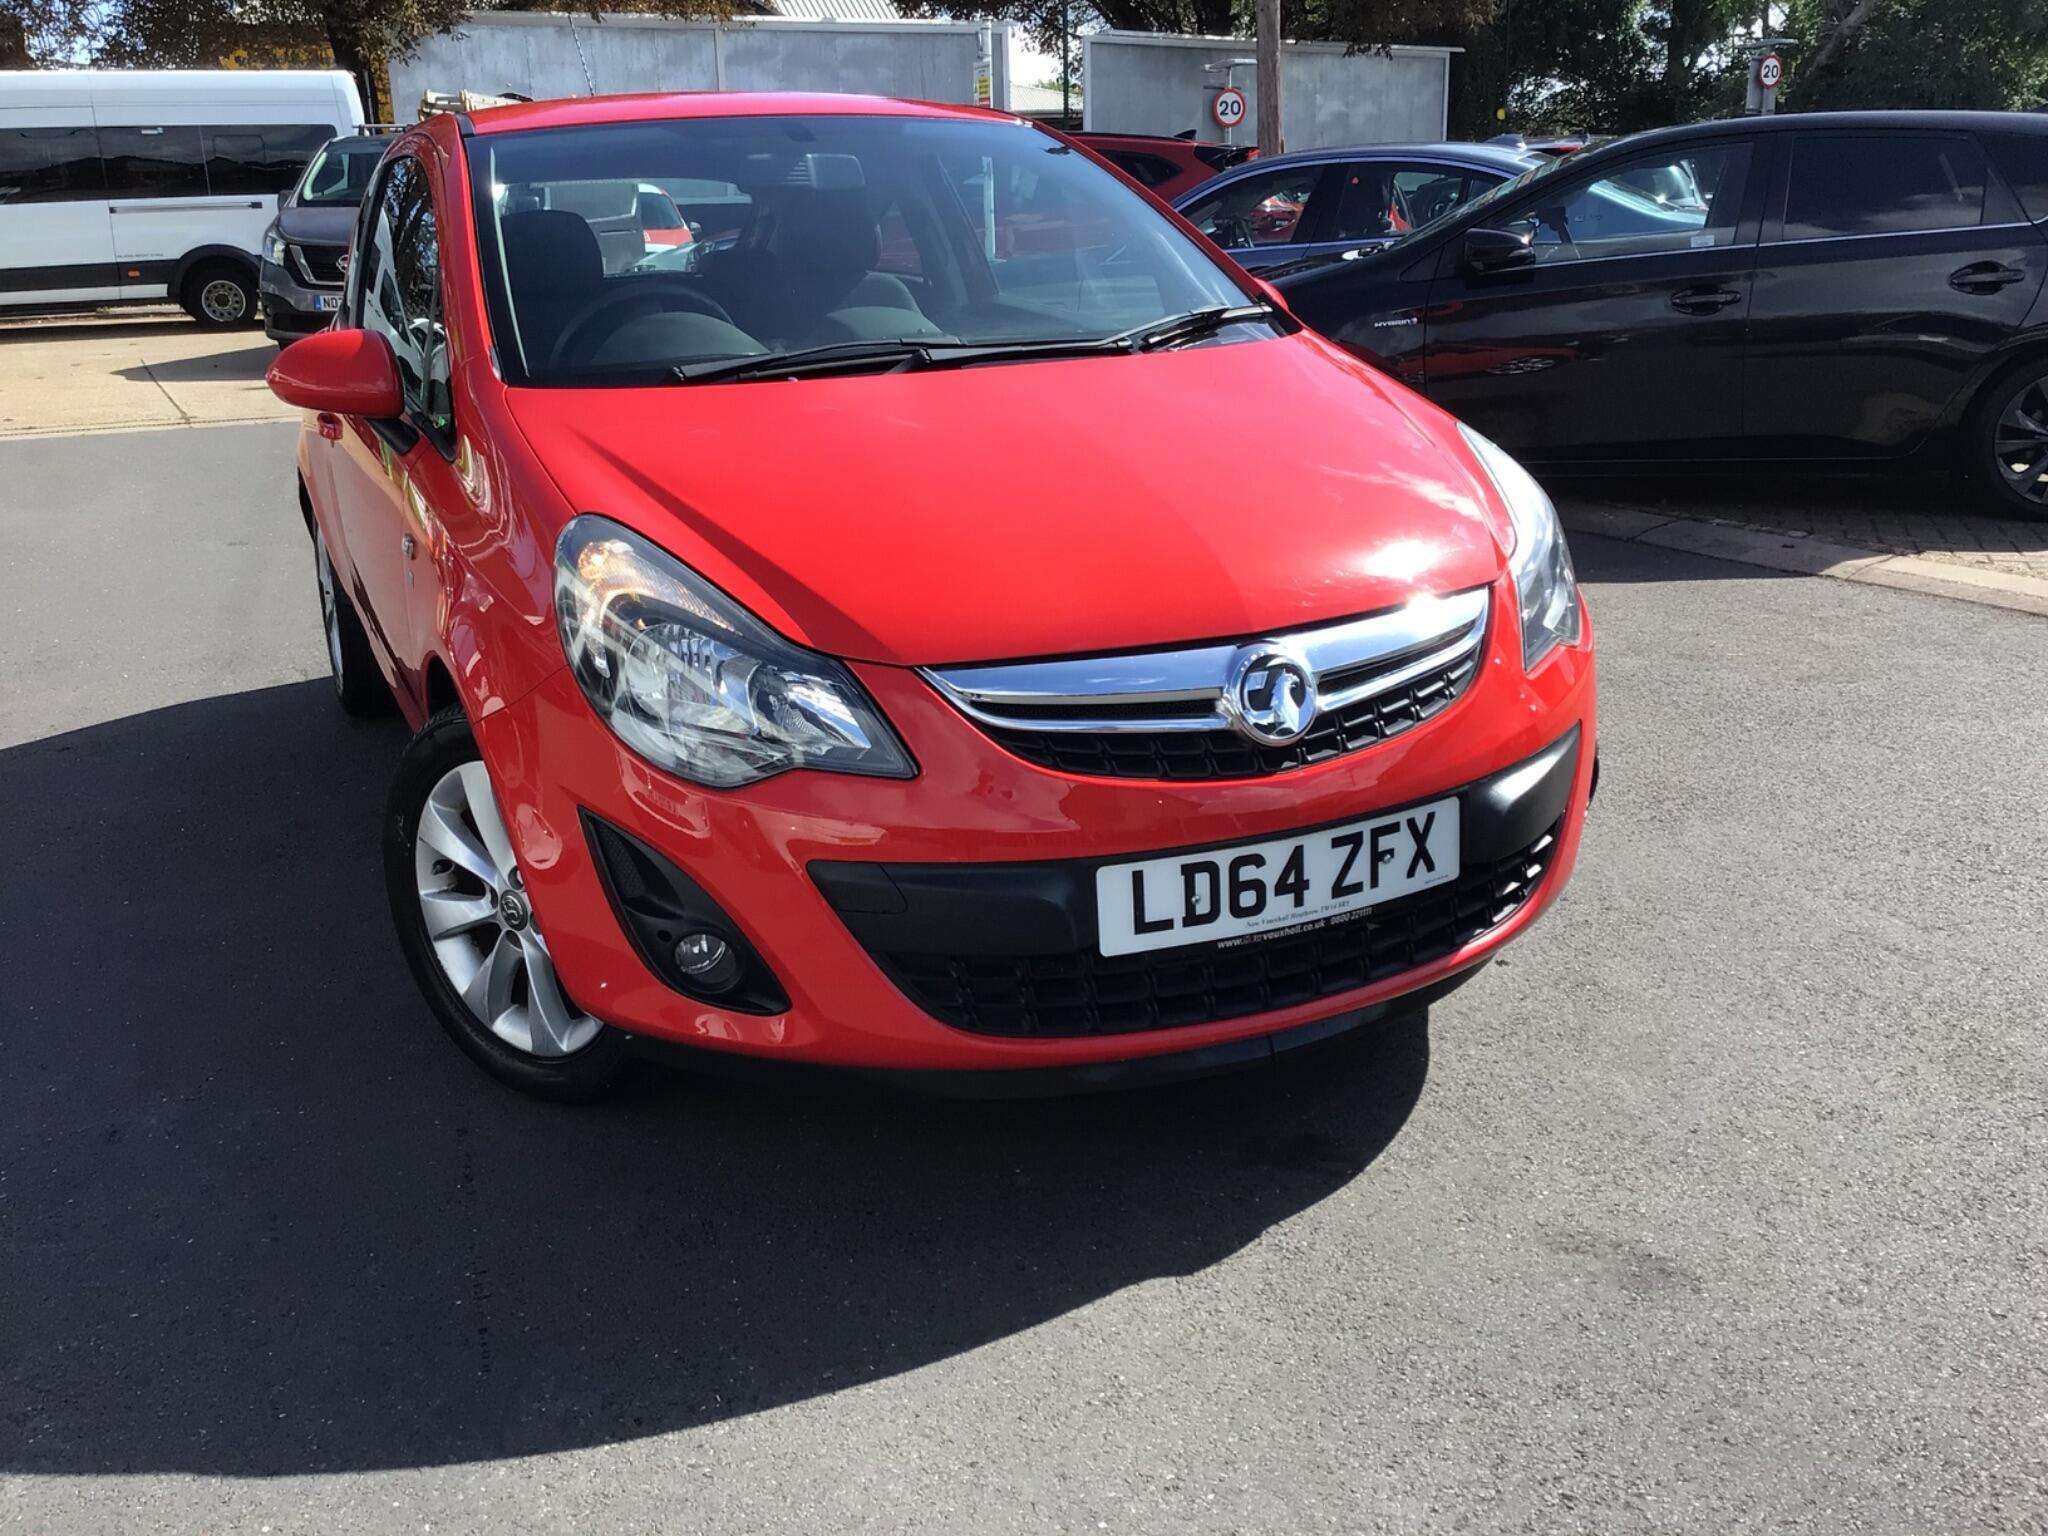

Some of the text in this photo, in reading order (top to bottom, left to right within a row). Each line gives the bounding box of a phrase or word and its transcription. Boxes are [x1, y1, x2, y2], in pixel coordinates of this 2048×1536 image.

[1763, 64, 1779, 79] 20
[1219, 100, 1241, 116] 20
[1131, 811, 1436, 936] LD64 ZFX
